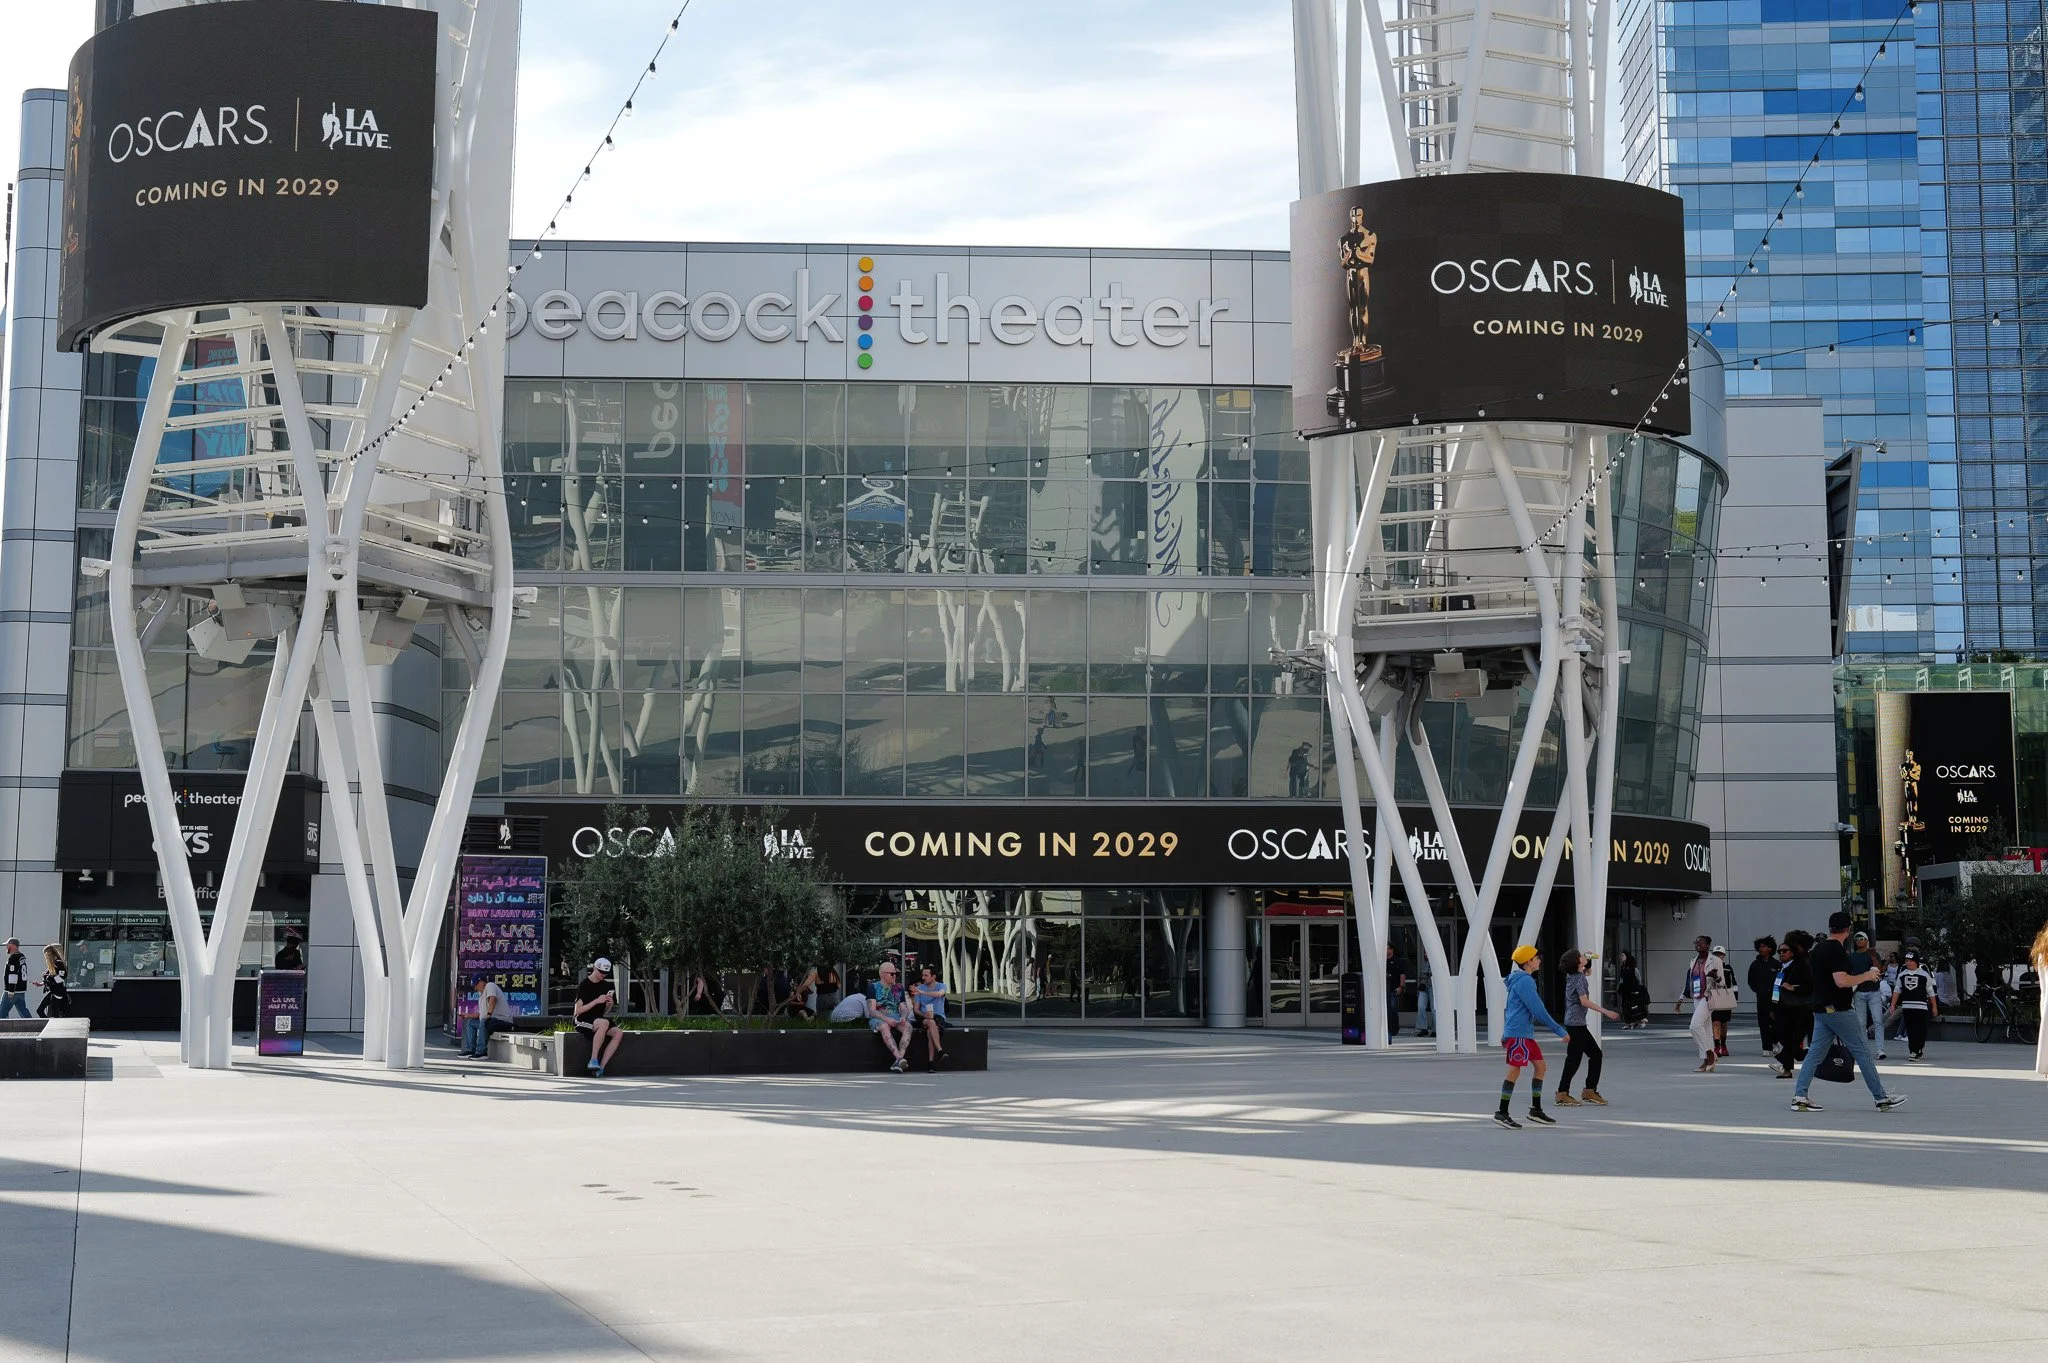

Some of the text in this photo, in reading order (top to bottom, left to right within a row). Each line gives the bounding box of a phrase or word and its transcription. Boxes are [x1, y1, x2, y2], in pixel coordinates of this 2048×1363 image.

[345, 108, 378, 132] LA
[109, 105, 269, 163] OSCARS
[345, 132, 390, 149] LIVE
[136, 178, 339, 207] COMING IN 2029
[1431, 258, 1594, 295] OSCARS
[1643, 271, 1662, 292] LA
[1643, 290, 1669, 307] LIVE
[890, 272, 1230, 347] theater
[1473, 320, 1643, 343] COMING IN 2029
[1936, 765, 1996, 778] OSCARS
[189, 792, 242, 805] theater
[1963, 790, 1974, 798] LA
[1948, 816, 1989, 824] COMING
[781, 829, 805, 846] LA
[1950, 825, 1988, 833] IN 2029
[865, 831, 1179, 857] COMING IN 2029
[1634, 841, 1669, 865] 2029
[501, 924, 535, 938] LIVE
[460, 939, 542, 953] HAS IT ALL
[495, 974, 507, 988] 다
[512, 974, 537, 988] 있다
[510, 992, 537, 1001] TODO
